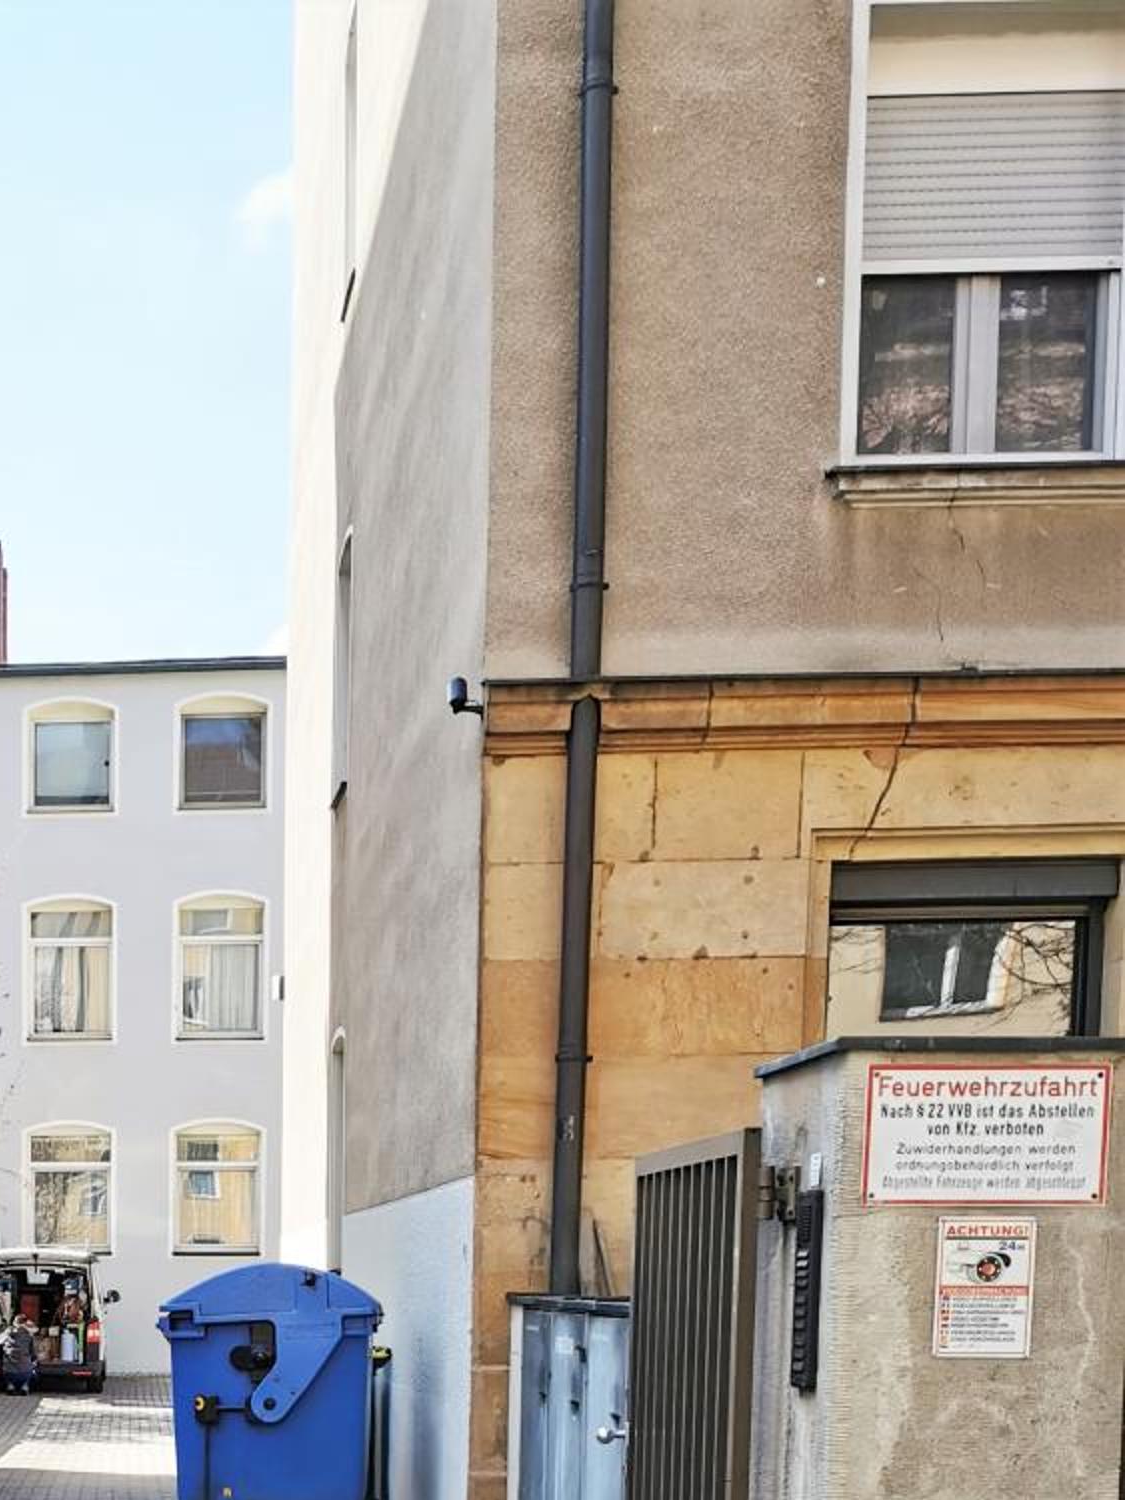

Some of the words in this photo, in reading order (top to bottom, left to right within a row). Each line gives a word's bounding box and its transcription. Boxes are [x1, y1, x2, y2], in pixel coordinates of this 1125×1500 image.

[878, 1076, 1098, 1097] Feuerwehrzufahrt
[880, 1103, 913, 1118] Nach
[927, 1103, 944, 1118] 22
[948, 1103, 973, 1118] VVB
[976, 1104, 994, 1118] ist
[998, 1103, 1023, 1118] das
[1028, 1103, 1094, 1118] Abstellen
[927, 1124, 950, 1135] von
[984, 1122, 1044, 1136] verboten
[896, 1142, 1021, 1156] Zuwiderhandlungen
[1028, 1143, 1076, 1154] werden
[1025, 1160, 1074, 1173] verfolgt
[947, 1225, 1028, 1236] ACHTUNG!
